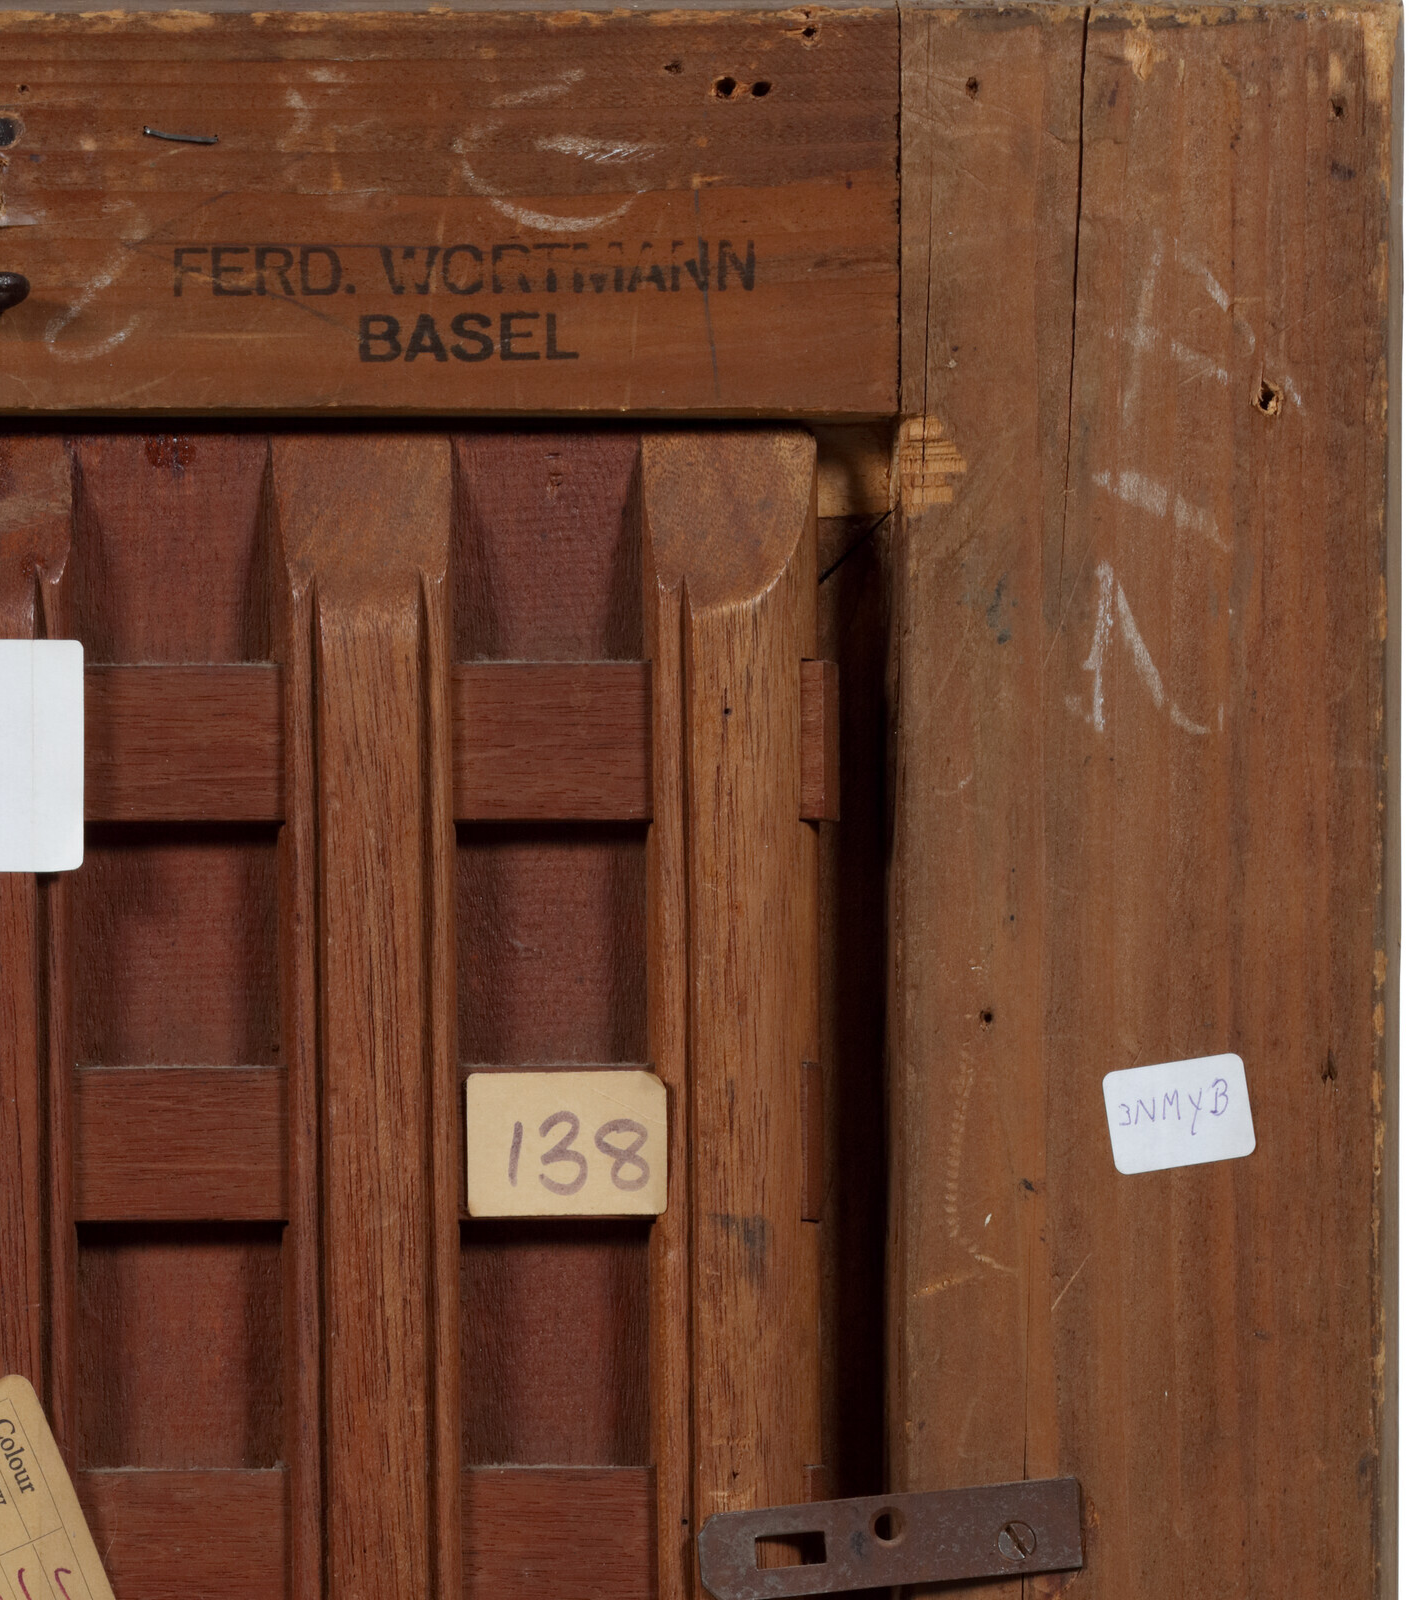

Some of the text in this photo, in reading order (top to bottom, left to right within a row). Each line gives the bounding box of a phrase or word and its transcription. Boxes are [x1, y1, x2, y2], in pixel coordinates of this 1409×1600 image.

[172, 239, 757, 299] FERD. WORTMANN
[357, 311, 579, 363] BASEL
[1118, 1078, 1228, 1136] 3NMYB
[508, 1110, 650, 1196] 138
